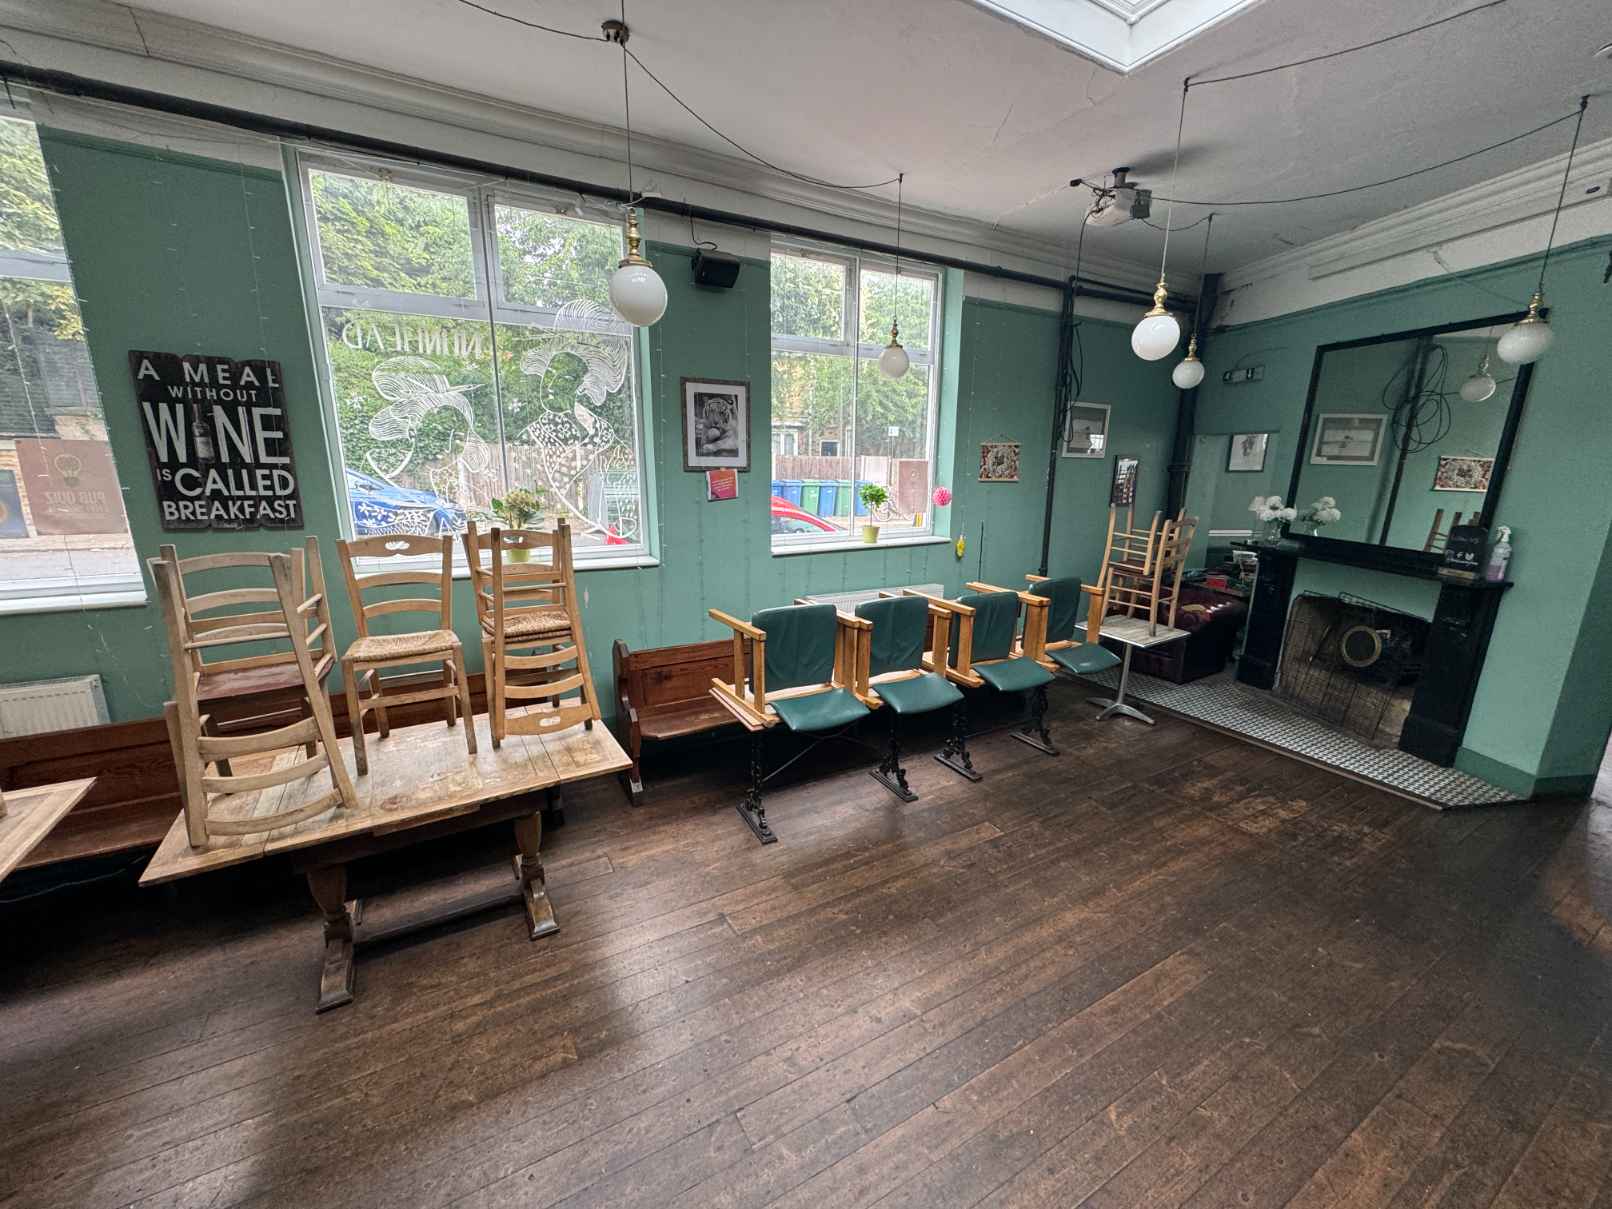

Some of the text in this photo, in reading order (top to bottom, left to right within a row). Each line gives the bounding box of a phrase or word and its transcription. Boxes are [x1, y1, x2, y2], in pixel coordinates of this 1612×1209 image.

[137, 359, 280, 387] A MEAL
[168, 385, 257, 402] WITHOUT
[156, 468, 295, 497] IS CALLED
[162, 500, 297, 520] BREAKFAST
